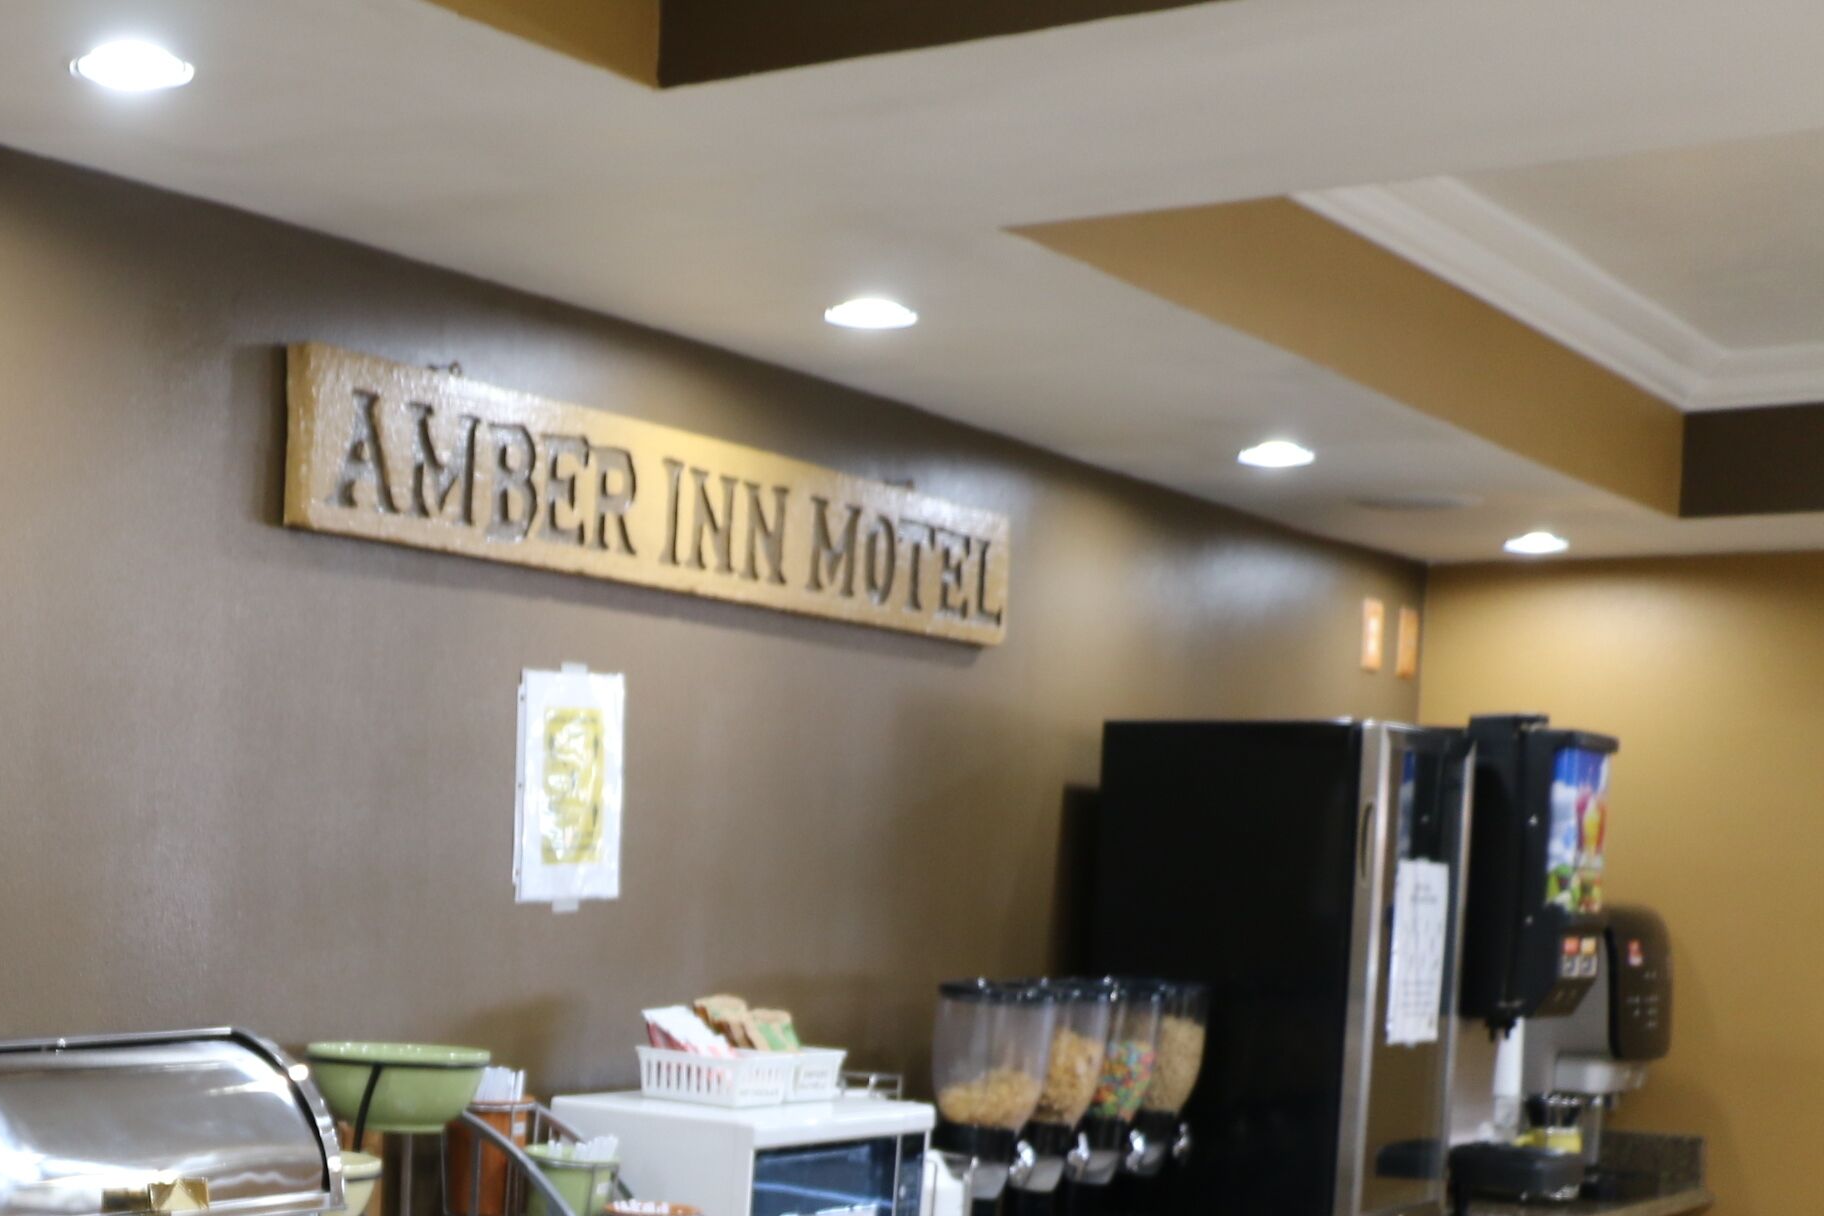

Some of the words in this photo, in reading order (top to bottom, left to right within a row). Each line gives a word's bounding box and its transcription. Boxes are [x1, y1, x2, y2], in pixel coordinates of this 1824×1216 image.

[326, 388, 637, 557] AMBER
[658, 457, 791, 587] INN
[805, 494, 1004, 627] MOTEL
